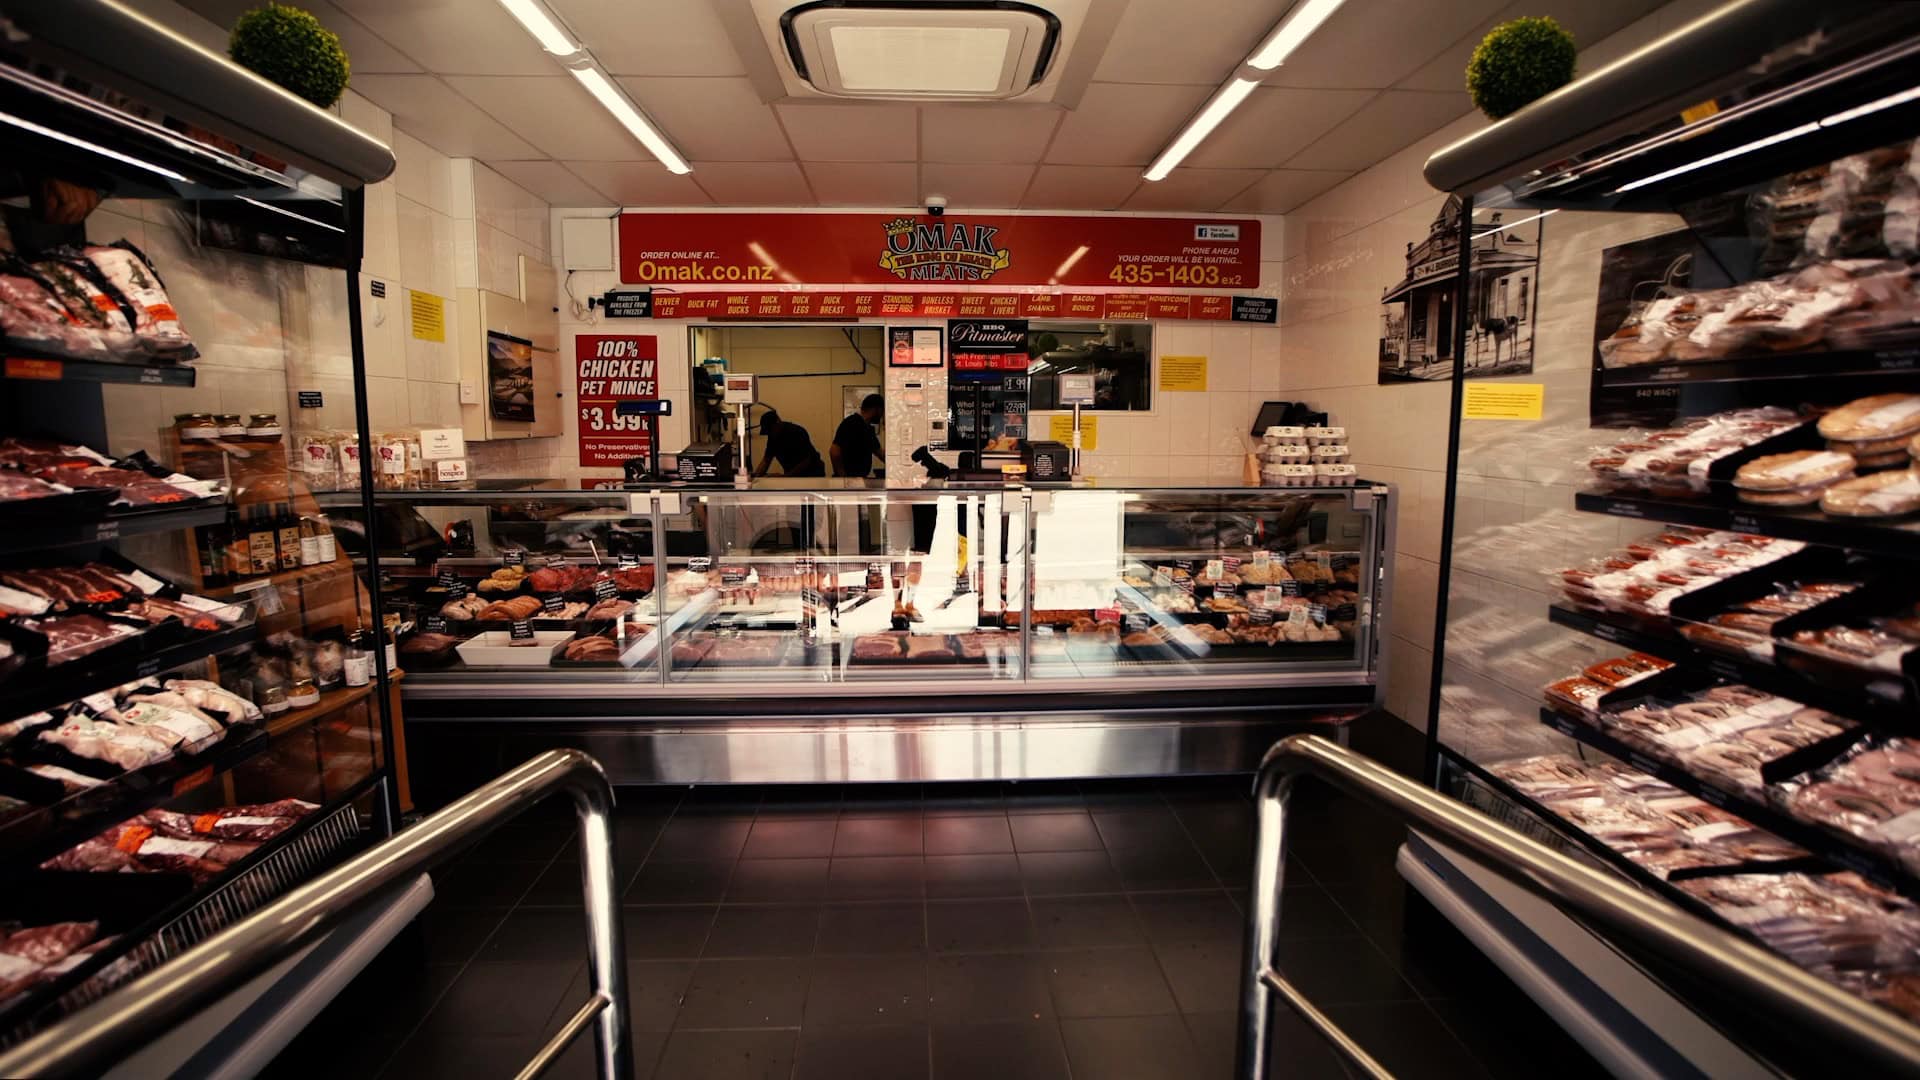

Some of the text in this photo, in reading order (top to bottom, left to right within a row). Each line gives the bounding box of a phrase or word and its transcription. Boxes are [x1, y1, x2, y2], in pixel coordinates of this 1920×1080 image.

[888, 223, 998, 255] OMAK
[1182, 247, 1239, 255] PHONE AHEAD
[1141, 255, 1171, 263] ORDER
[1204, 256, 1243, 264] WAITING...
[639, 261, 774, 281] Omak.co.nz
[910, 264, 980, 280] MEATS
[1109, 265, 1242, 285] 435-1403 ex2
[655, 298, 680, 306] DENVER
[687, 300, 719, 308] DUCK FAT
[727, 296, 749, 304] WHOLE
[760, 296, 778, 304] DUCK
[792, 296, 809, 304] DUCK
[823, 296, 841, 304] DUCK
[856, 296, 872, 304] BEEF
[882, 296, 913, 304] STANDING
[922, 296, 954, 304] BONELESS
[962, 296, 984, 304] SWEET
[990, 297, 1017, 305] CHICKEN
[661, 307, 675, 315] LEG
[728, 306, 749, 314] DUCKS
[759, 305, 781, 314] LIVERS
[793, 305, 809, 314] LEGS
[820, 306, 845, 314] BREAST
[856, 305, 872, 314] RIBS
[882, 304, 914, 313] BEEF RIBS
[924, 306, 952, 314] BRISKET
[960, 306, 985, 314] BREADS
[993, 306, 1015, 315] LIVERS
[951, 322, 1025, 343] Pitmaster
[597, 341, 638, 358] 100%
[579, 359, 655, 378] CHICKEN
[580, 380, 655, 396] PET MINCE
[642, 419, 650, 431] k
